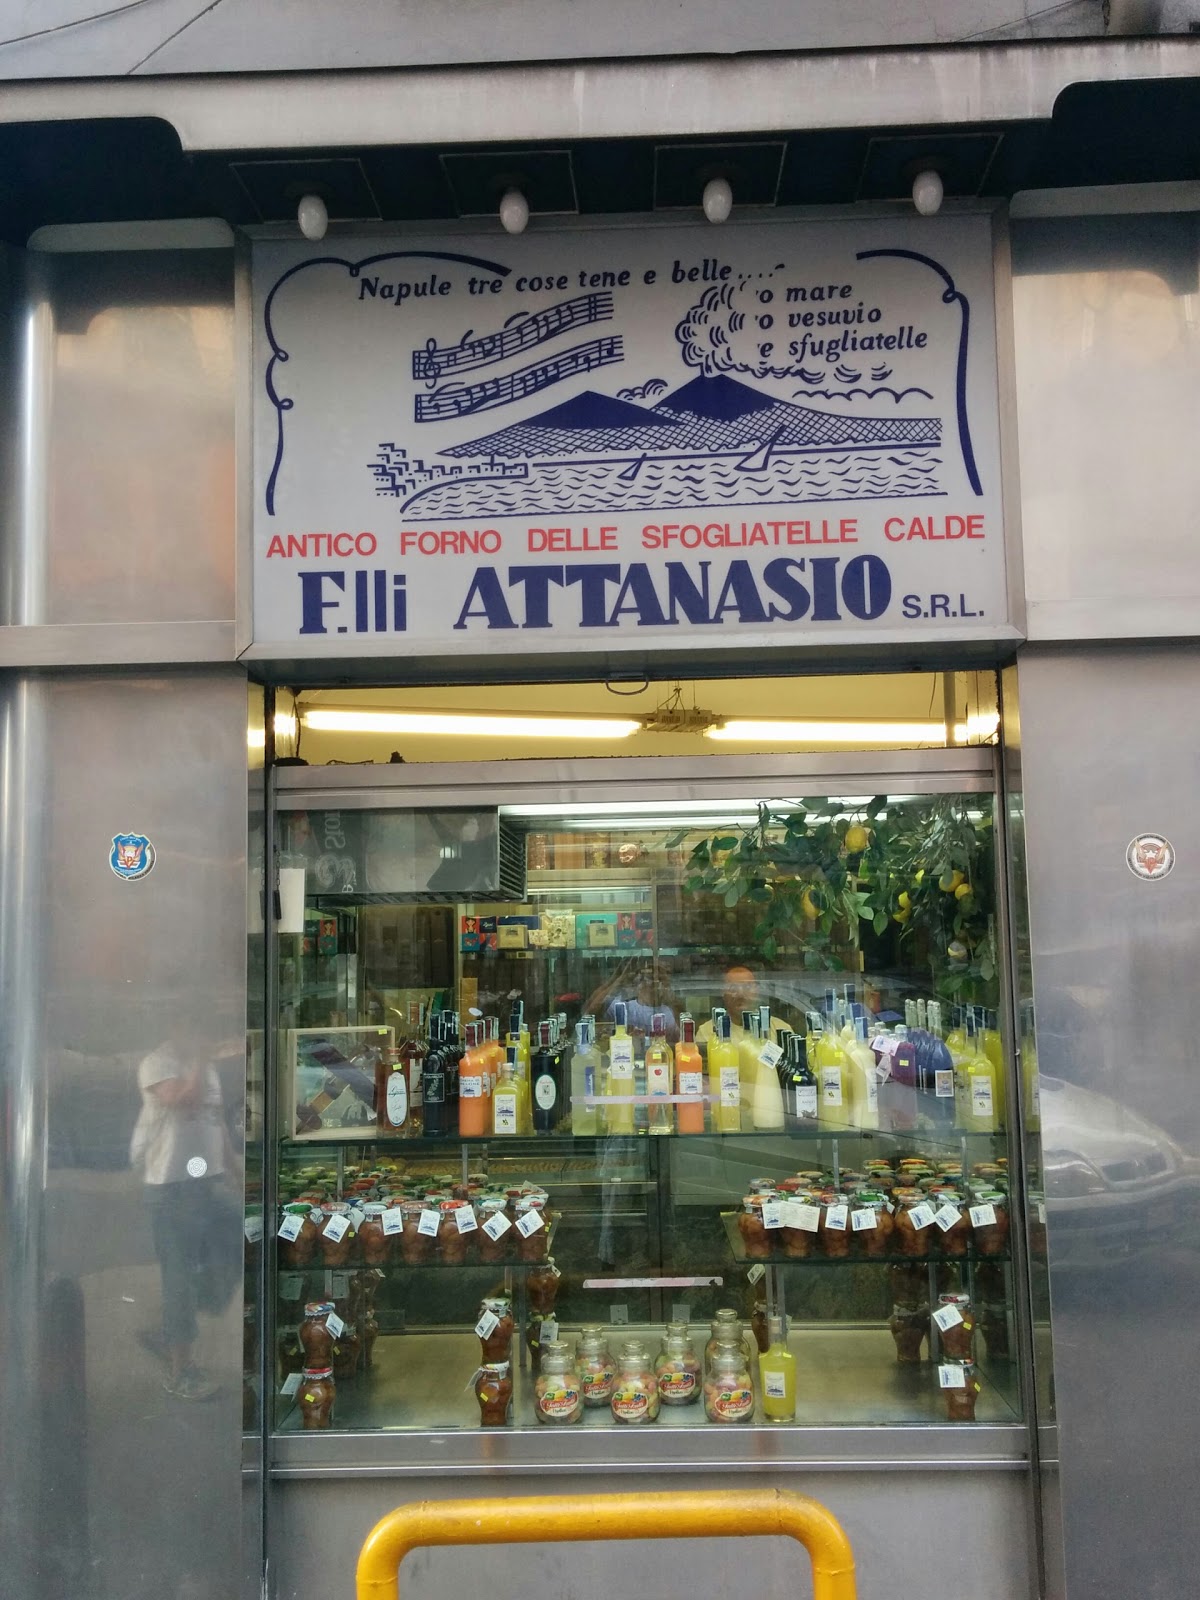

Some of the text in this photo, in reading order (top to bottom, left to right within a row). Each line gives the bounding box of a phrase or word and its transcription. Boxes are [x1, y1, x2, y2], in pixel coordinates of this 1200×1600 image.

[359, 273, 452, 305] Napule
[468, 275, 503, 295] tre
[515, 276, 569, 293] cose
[579, 267, 631, 290] tene
[643, 269, 657, 285] e
[787, 283, 853, 303] mare
[788, 302, 882, 329] vesuvio
[788, 326, 928, 363] sfugliatelle
[266, 514, 985, 558] ANTICO FORNO DELLE SFOGLIATELLE CALDE
[297, 553, 985, 635] F.lli ATTANASIO S.R.L.
